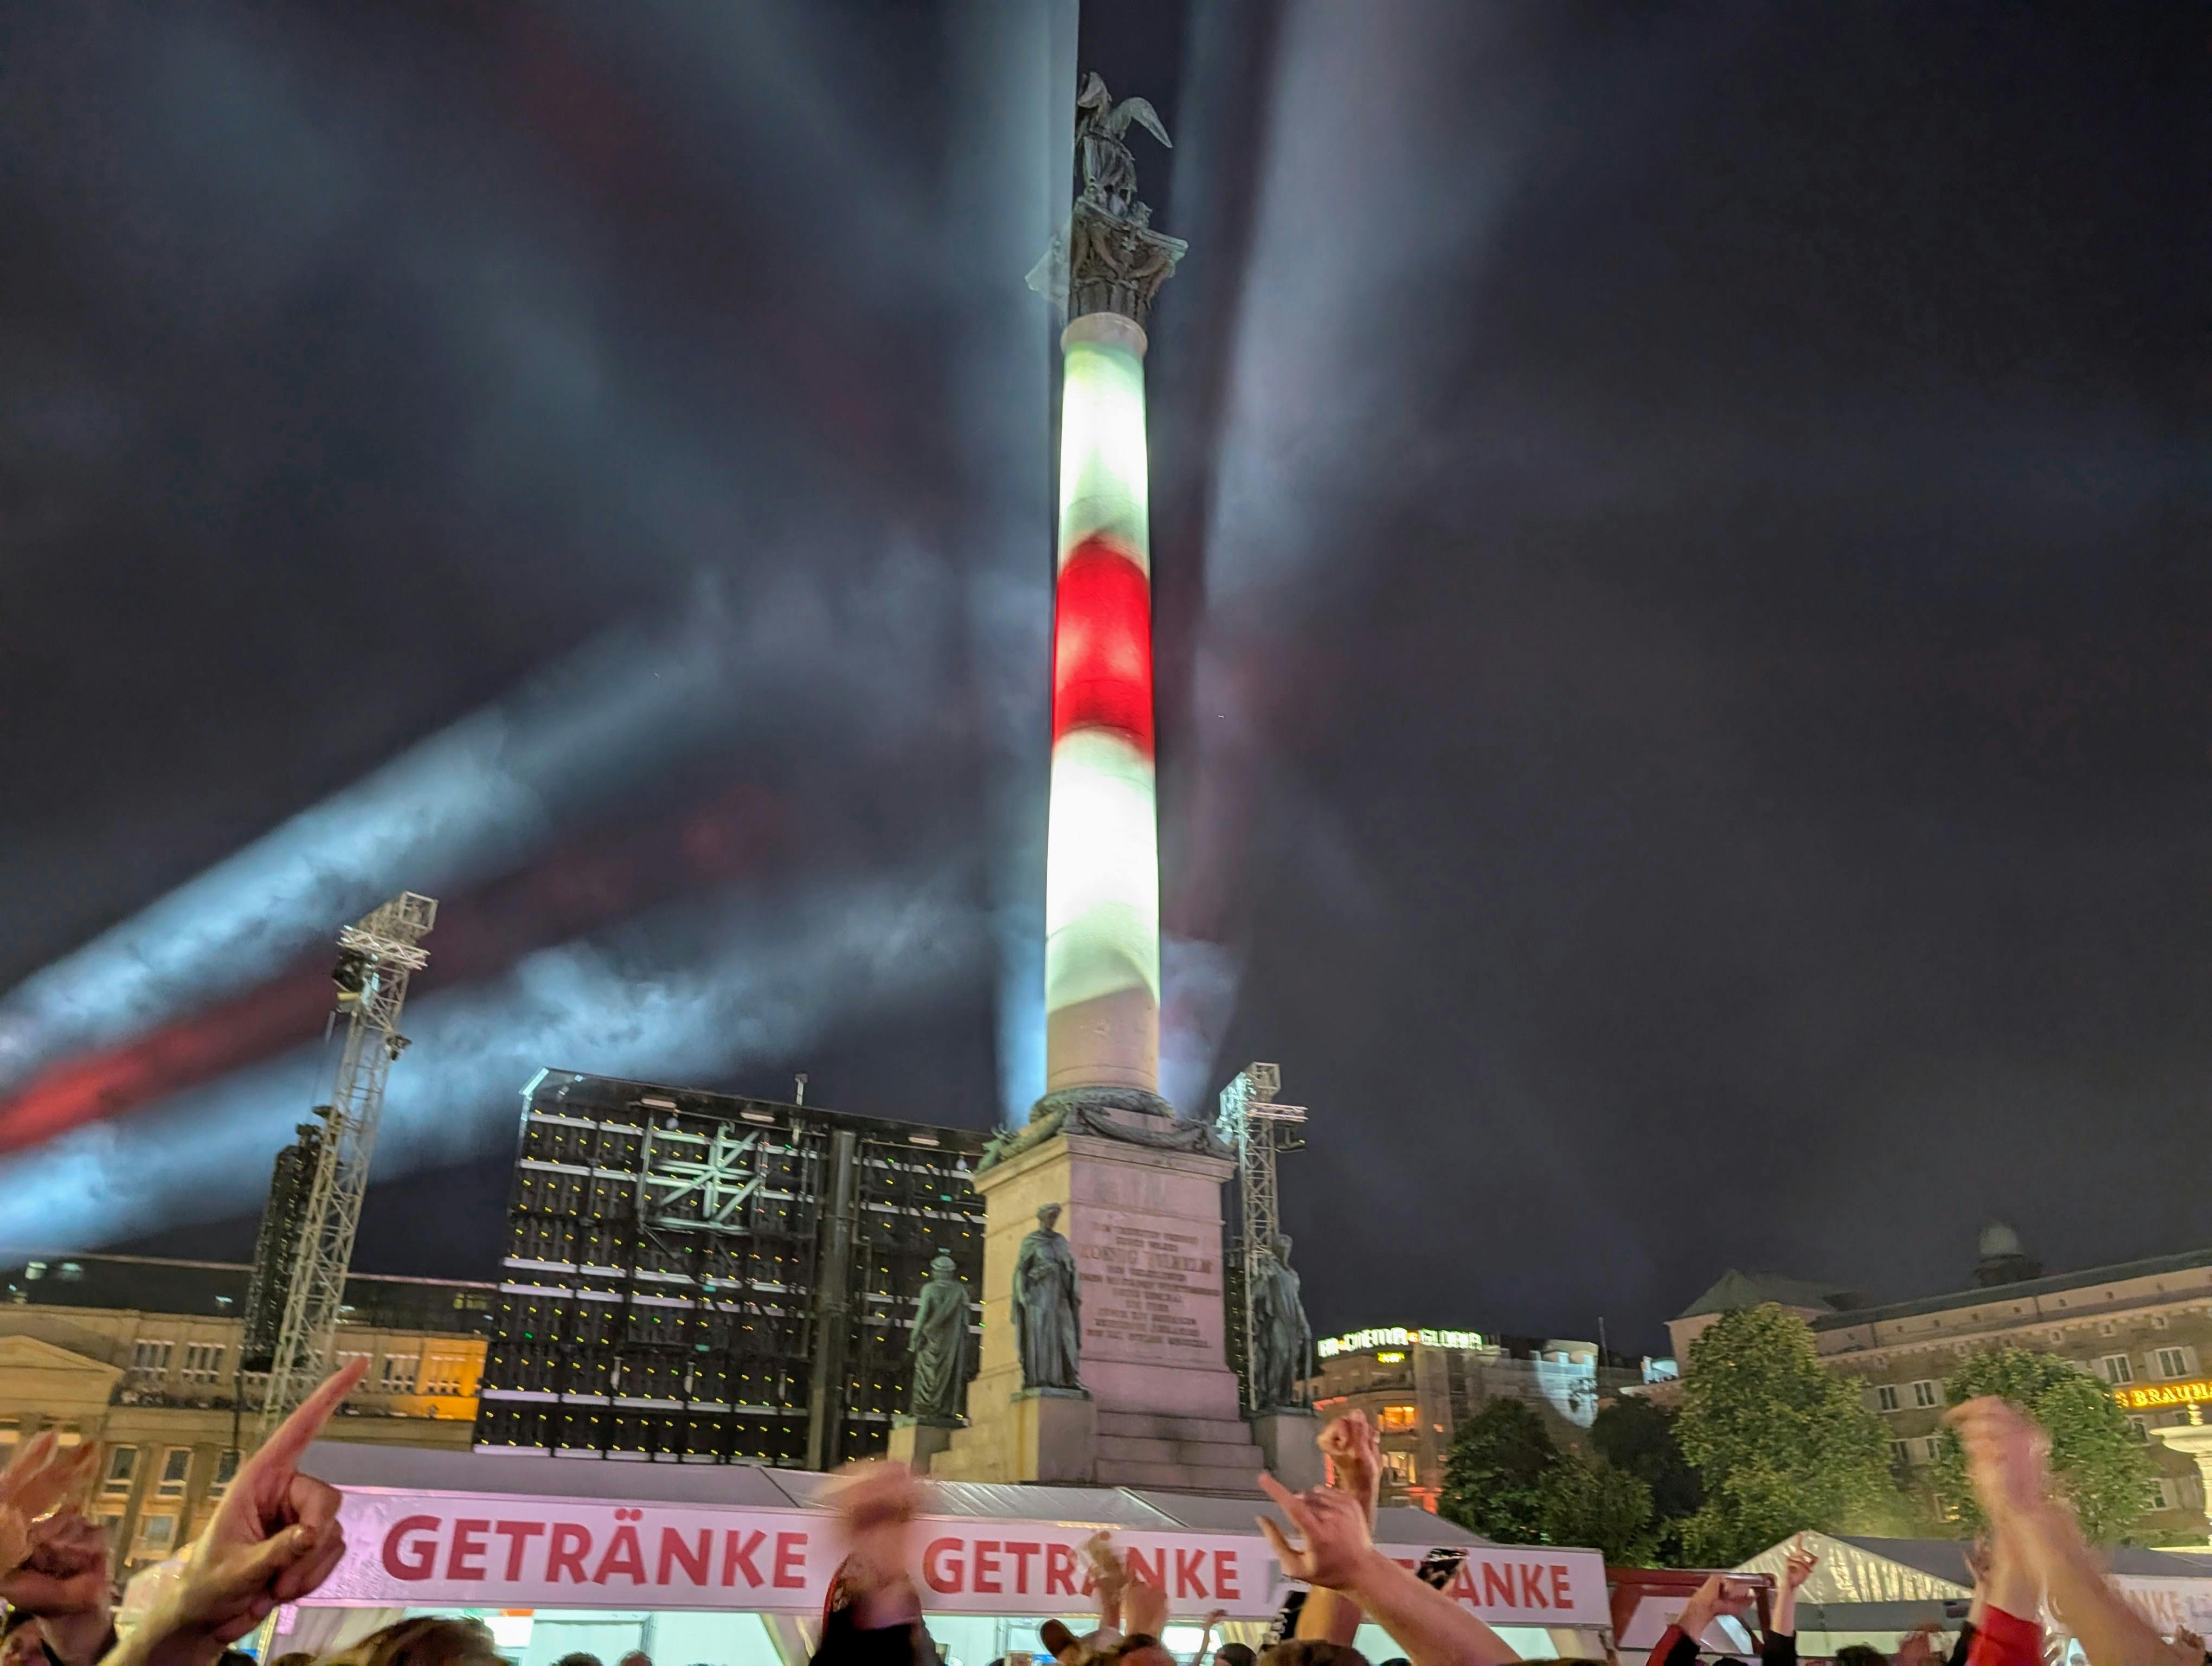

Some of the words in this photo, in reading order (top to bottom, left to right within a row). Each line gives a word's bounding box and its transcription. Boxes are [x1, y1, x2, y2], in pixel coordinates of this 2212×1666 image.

[1417, 1328, 1483, 1350] GLORIA
[2130, 1382, 2212, 1406] BRAUH
[382, 1508, 809, 1588] GETRÄNKE
